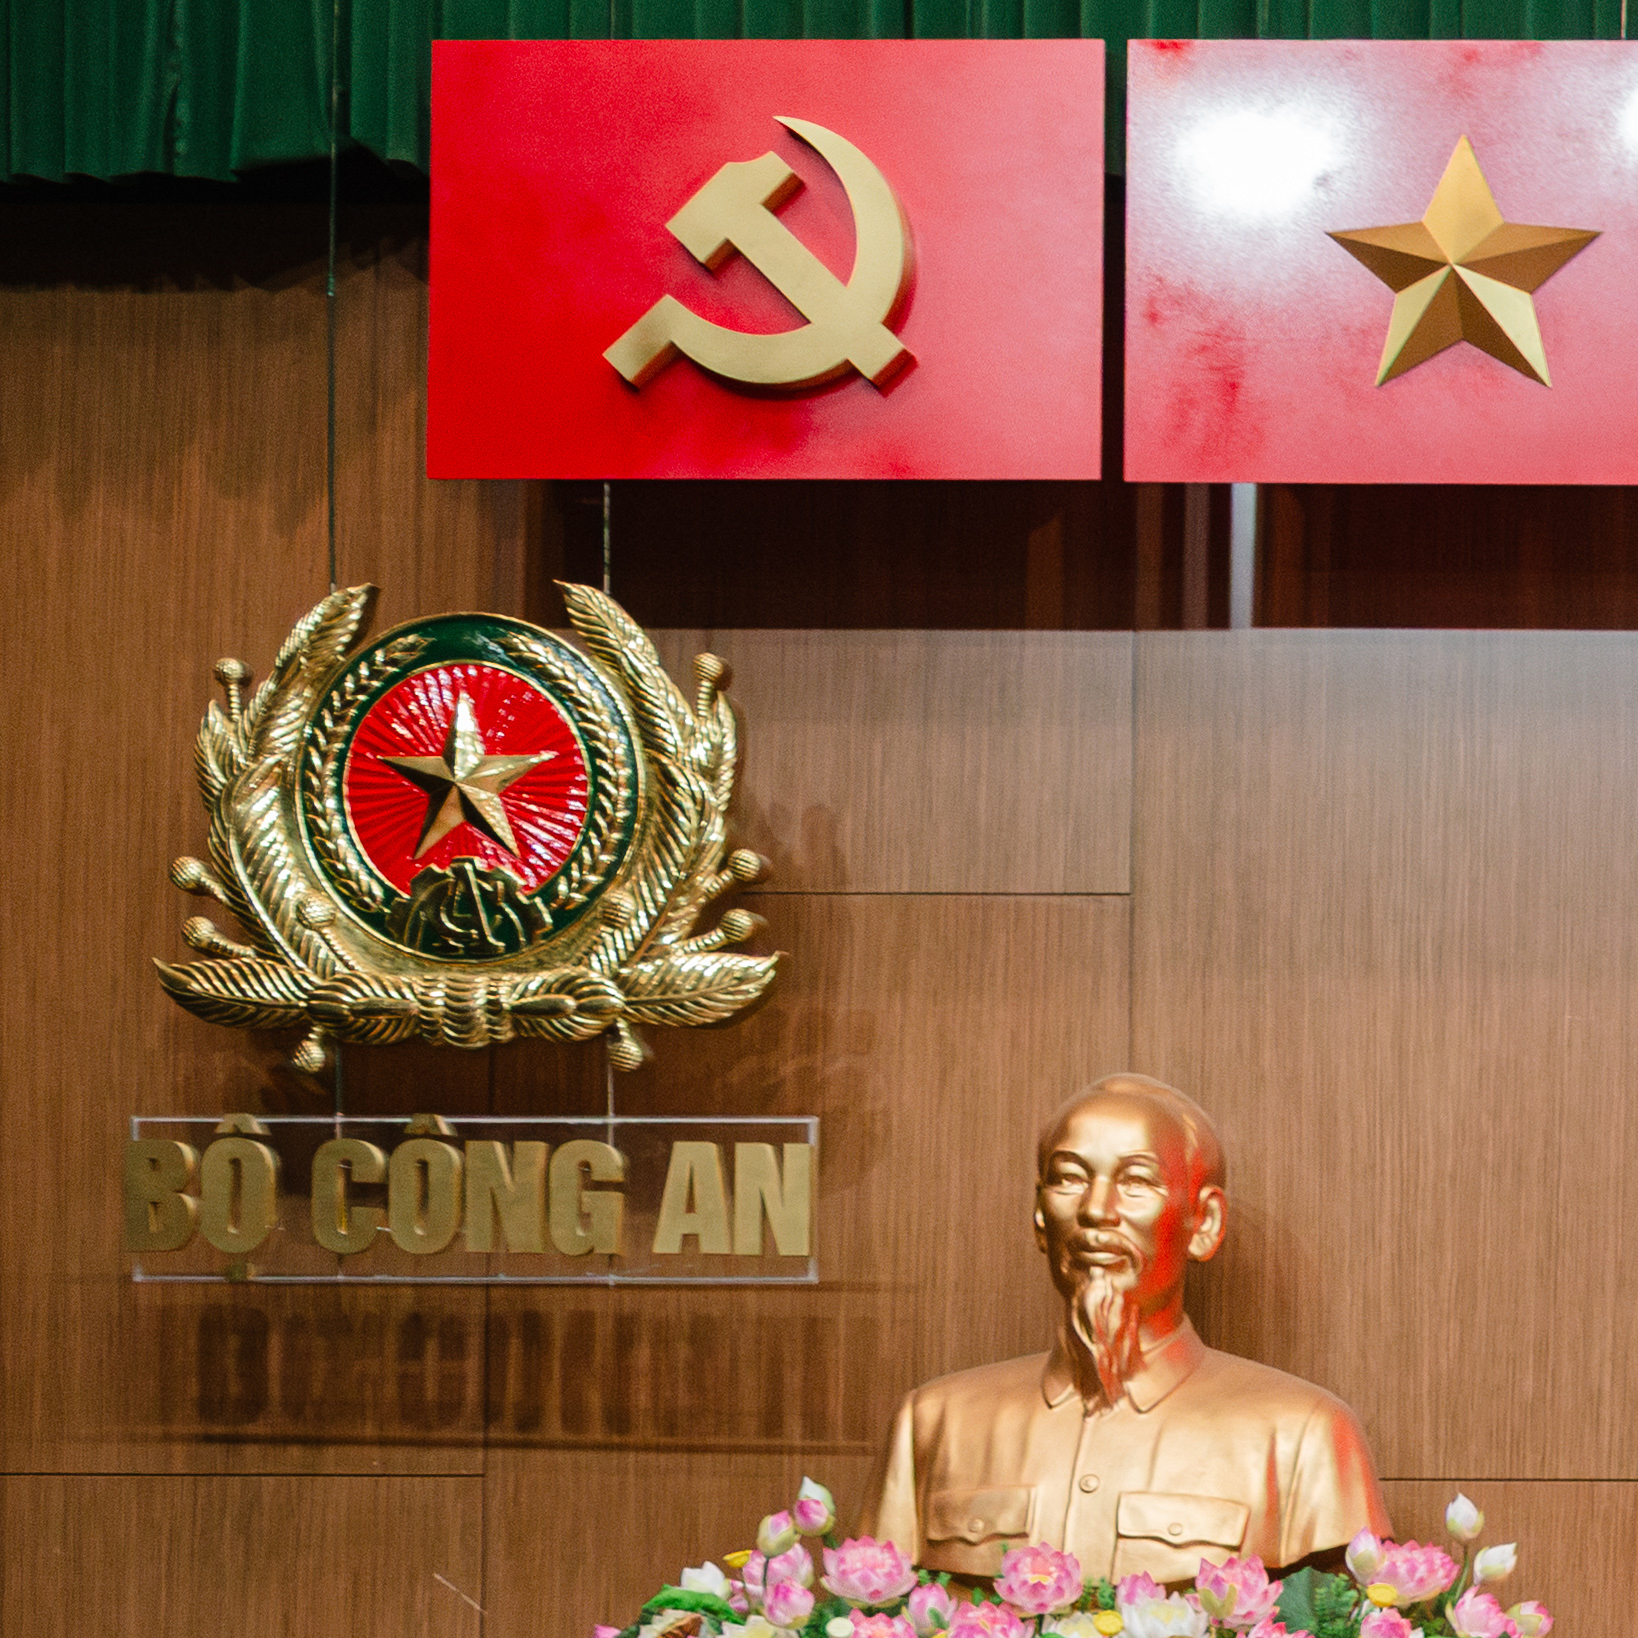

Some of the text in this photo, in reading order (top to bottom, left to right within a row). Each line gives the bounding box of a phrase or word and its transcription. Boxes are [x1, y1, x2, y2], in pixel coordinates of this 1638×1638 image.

[123, 1113, 813, 1282] BỘ CÔNG AN
